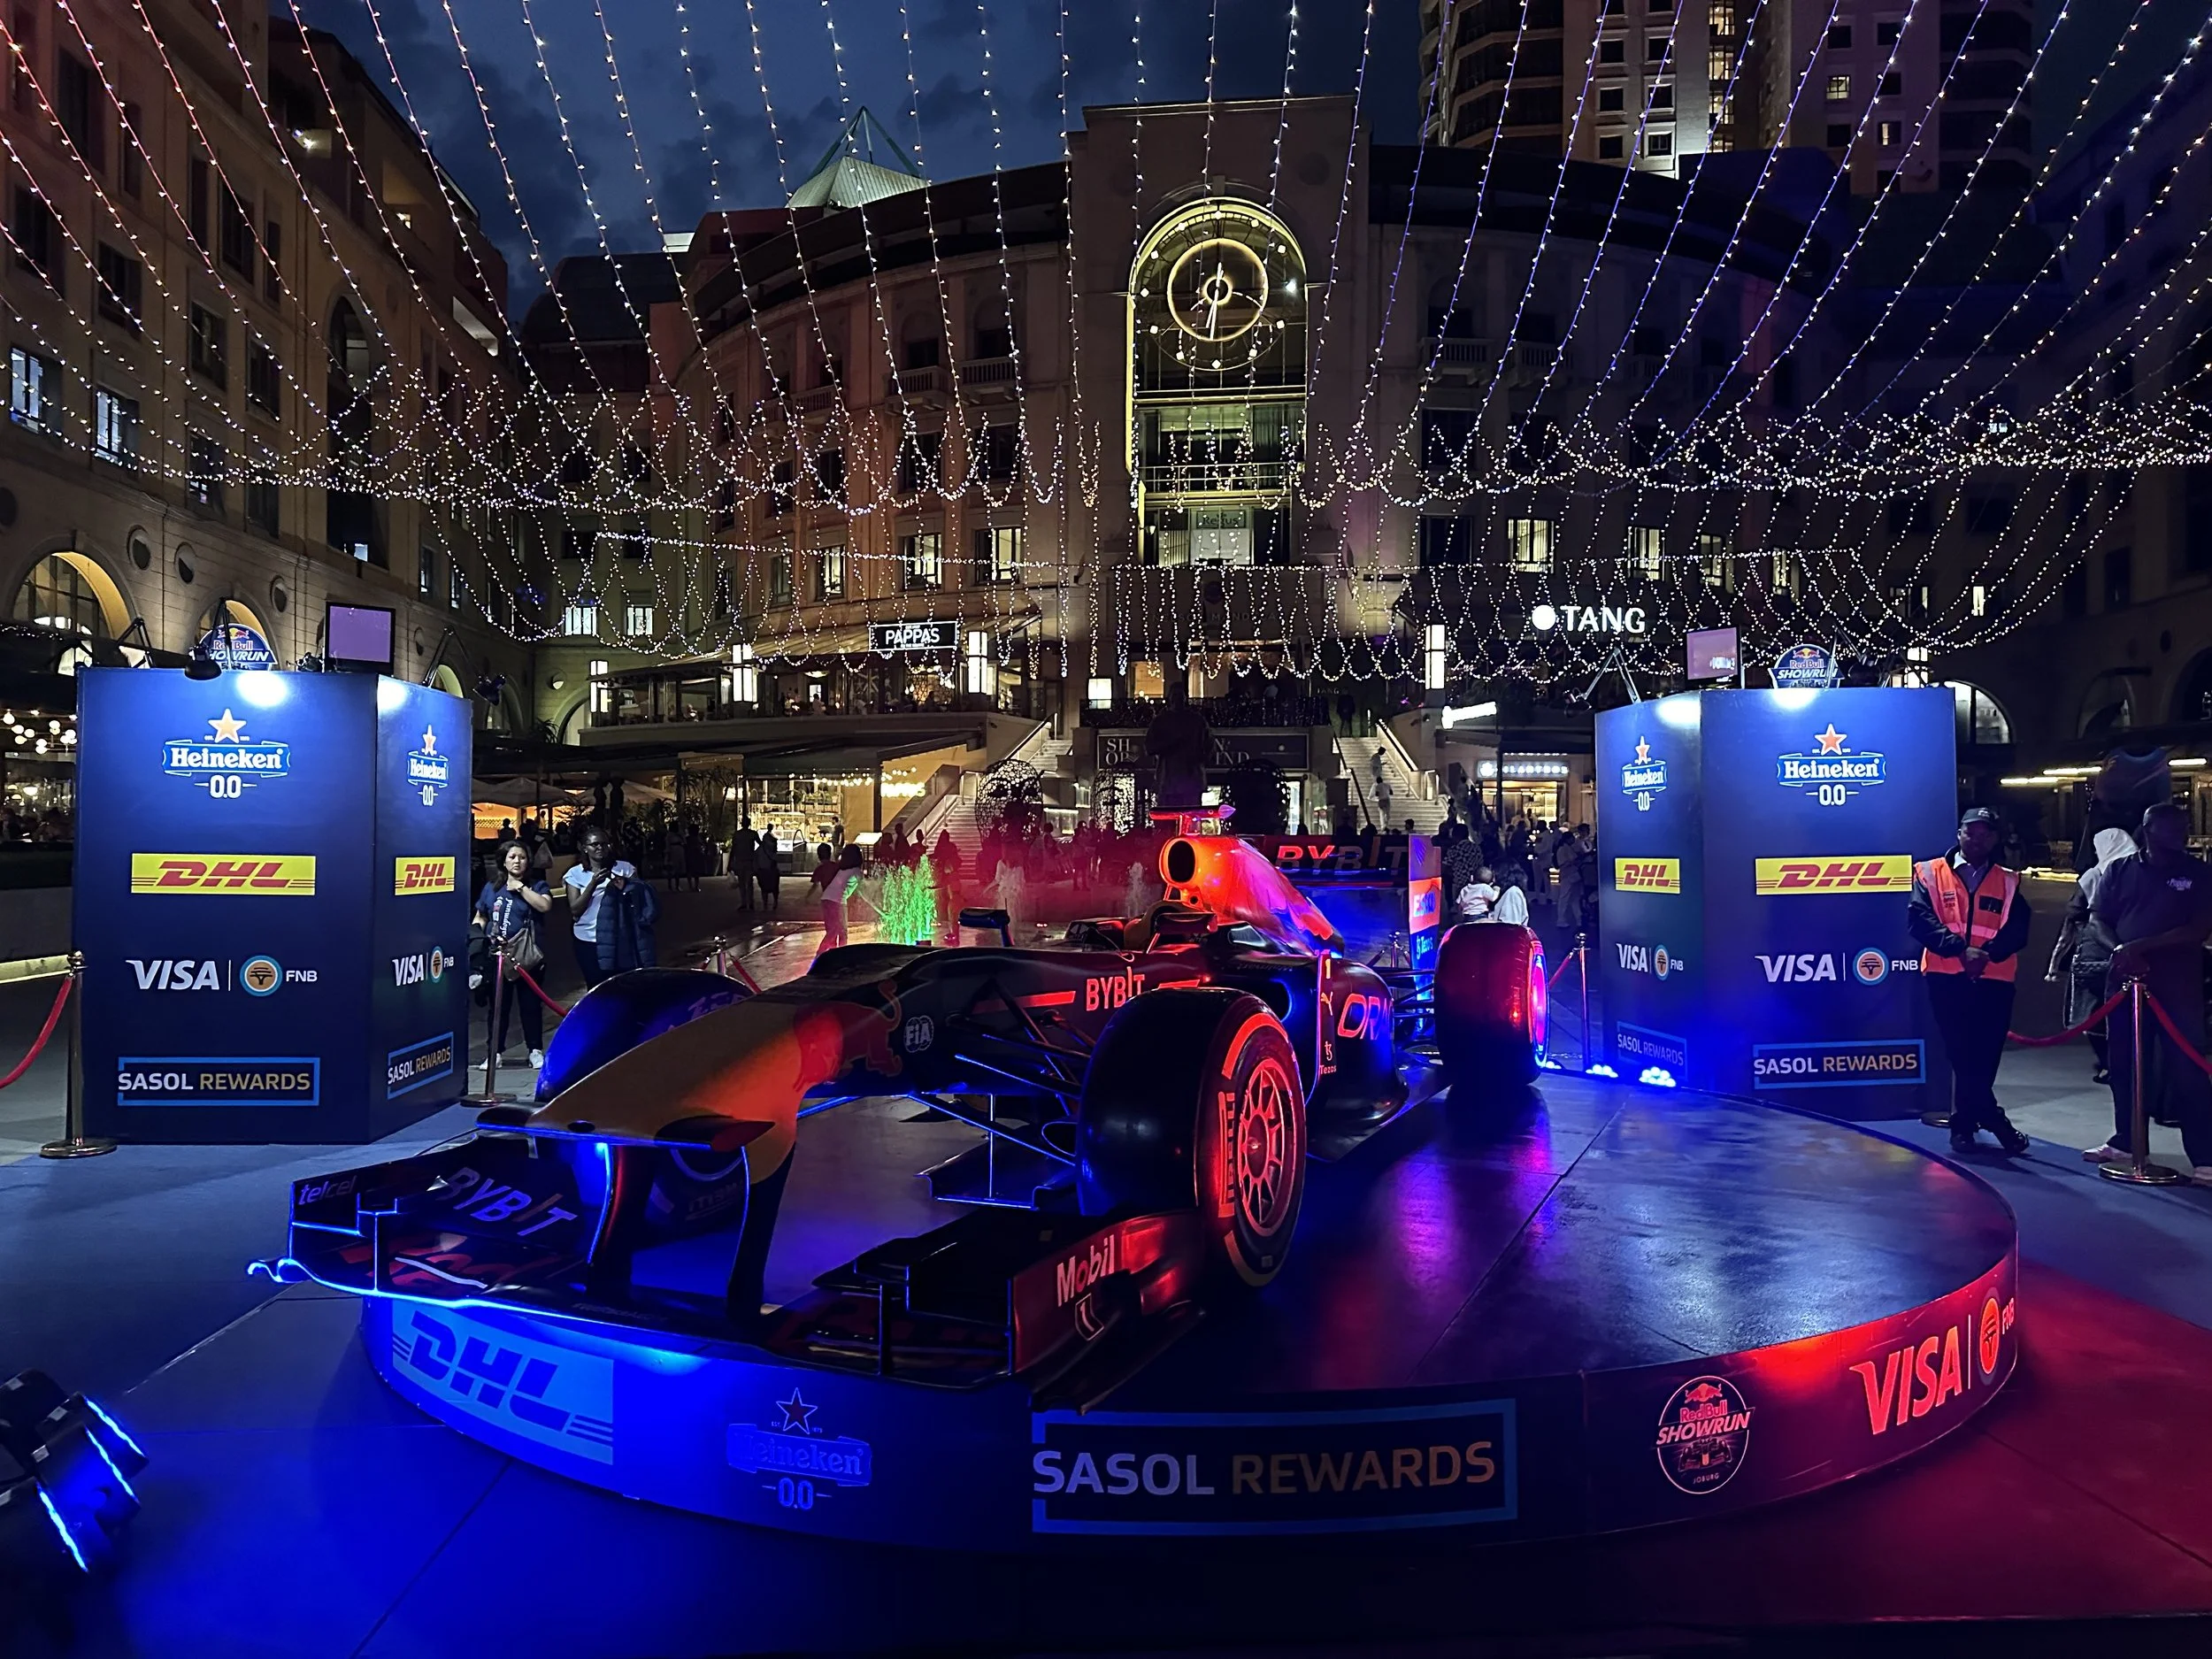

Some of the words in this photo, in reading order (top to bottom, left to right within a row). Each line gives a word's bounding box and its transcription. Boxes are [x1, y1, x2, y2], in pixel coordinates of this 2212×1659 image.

[1202, 515, 1239, 527] Regus
[1559, 605, 1646, 634] TANG
[213, 640, 232, 650] Re
[234, 640, 254, 650] Bull
[885, 627, 941, 645] PAPPAS
[209, 649, 269, 661] HORUN
[1790, 658, 1807, 668] Red
[1808, 658, 1824, 668] Bull
[170, 747, 282, 770] Heineken
[410, 757, 448, 780] Heineken
[1783, 758, 1880, 780] Heineken
[210, 774, 242, 799] 0.0
[1624, 766, 1664, 788] Heineken
[422, 784, 434, 806] 0.0
[1637, 790, 1650, 811] 0.0
[1818, 783, 1846, 806] 0.0
[1274, 835, 1409, 876] BYBIT
[156, 860, 291, 888] DHL
[403, 862, 447, 888] DHL
[1623, 864, 1671, 887] DHL
[1777, 861, 1892, 888] DHL
[499, 897, 514, 938] akopmund
[392, 954, 425, 987] VISA
[443, 956, 455, 969] FNB
[1616, 943, 1648, 973] VISA
[1670, 958, 1684, 972] FNB
[1755, 953, 1837, 983] VISA
[1891, 959, 1919, 972] FNB
[125, 959, 220, 991] VISA
[285, 970, 318, 983] FNB
[1086, 965, 1146, 1012] BYBIT
[1337, 993, 1394, 1041] ORA
[1617, 1033, 1643, 1055] SASOL
[1643, 1041, 1684, 1067] REWARDS
[388, 1060, 415, 1085] SASOL
[415, 1046, 451, 1073] REWARDS
[1319, 1064, 1337, 1075] Tezos
[1753, 1056, 1819, 1075] SASOL
[1823, 1053, 1918, 1073] REWARDS
[117, 1071, 194, 1091] SASOL
[199, 1071, 311, 1091] REWARDS
[297, 1174, 357, 1206] telcel
[434, 1165, 580, 1238] BYBIT
[1056, 1233, 1116, 1308] Mobil
[409, 1310, 572, 1433] DHL
[1848, 1325, 1962, 1435] VISA
[2001, 1297, 2015, 1335] FNB
[1679, 1402, 1704, 1424] Red
[1703, 1399, 1728, 1419] Bull
[1655, 1411, 1751, 1446] SHOWRUN
[733, 1432, 864, 1477] Heineken
[1032, 1450, 1216, 1496] SASOL
[1232, 1440, 1496, 1495] REWARDS
[1693, 1472, 1720, 1485] JOBURG
[778, 1477, 814, 1511] 0.0
